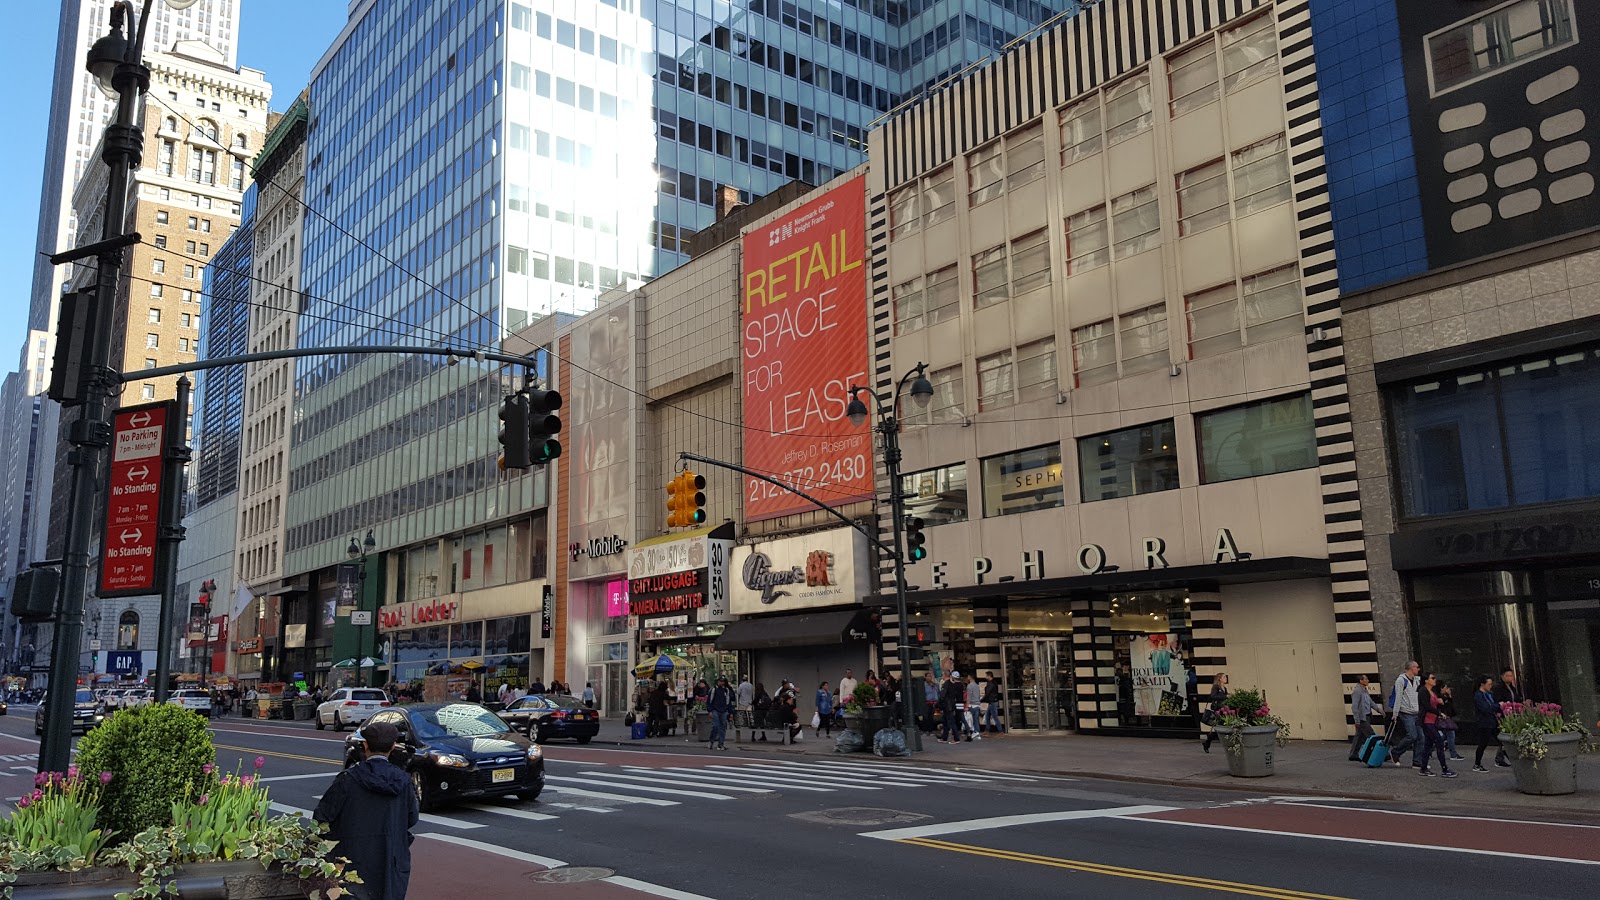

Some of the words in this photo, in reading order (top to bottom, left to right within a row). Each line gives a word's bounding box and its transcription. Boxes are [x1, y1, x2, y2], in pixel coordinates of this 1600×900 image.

[794, 209, 818, 226] Newmark
[818, 200, 835, 213] Grubb
[794, 221, 811, 235] Knight
[811, 213, 826, 226] Frank
[746, 229, 862, 314] RETAIL
[745, 287, 838, 358] SPACE
[746, 360, 783, 397] FOR
[119, 432, 130, 443] No
[131, 429, 159, 442] Parking
[123, 446, 132, 454] pm
[135, 442, 156, 451] Midnight
[781, 449, 808, 464] Jeffrey
[809, 444, 819, 458] D.
[821, 435, 863, 455] Roseman
[750, 454, 866, 502] 212.372.2430
[113, 486, 123, 496] No
[124, 482, 157, 494] Standing
[135, 503, 139, 511] 7
[139, 504, 148, 512] pm
[115, 515, 132, 523] Monday
[108, 548, 118, 558] No
[119, 545, 152, 557] Standing
[711, 542, 723, 567] 30
[109, 576, 127, 584] Saturday
[130, 574, 146, 582] Sunday
[116, 566, 125, 575] pm
[135, 565, 144, 573] pm
[712, 576, 724, 600] 50
[815, 589, 833, 597] FASHION
[377, 606, 406, 630] Foot
[411, 600, 458, 624] Locker
[116, 656, 132, 669] GAP
